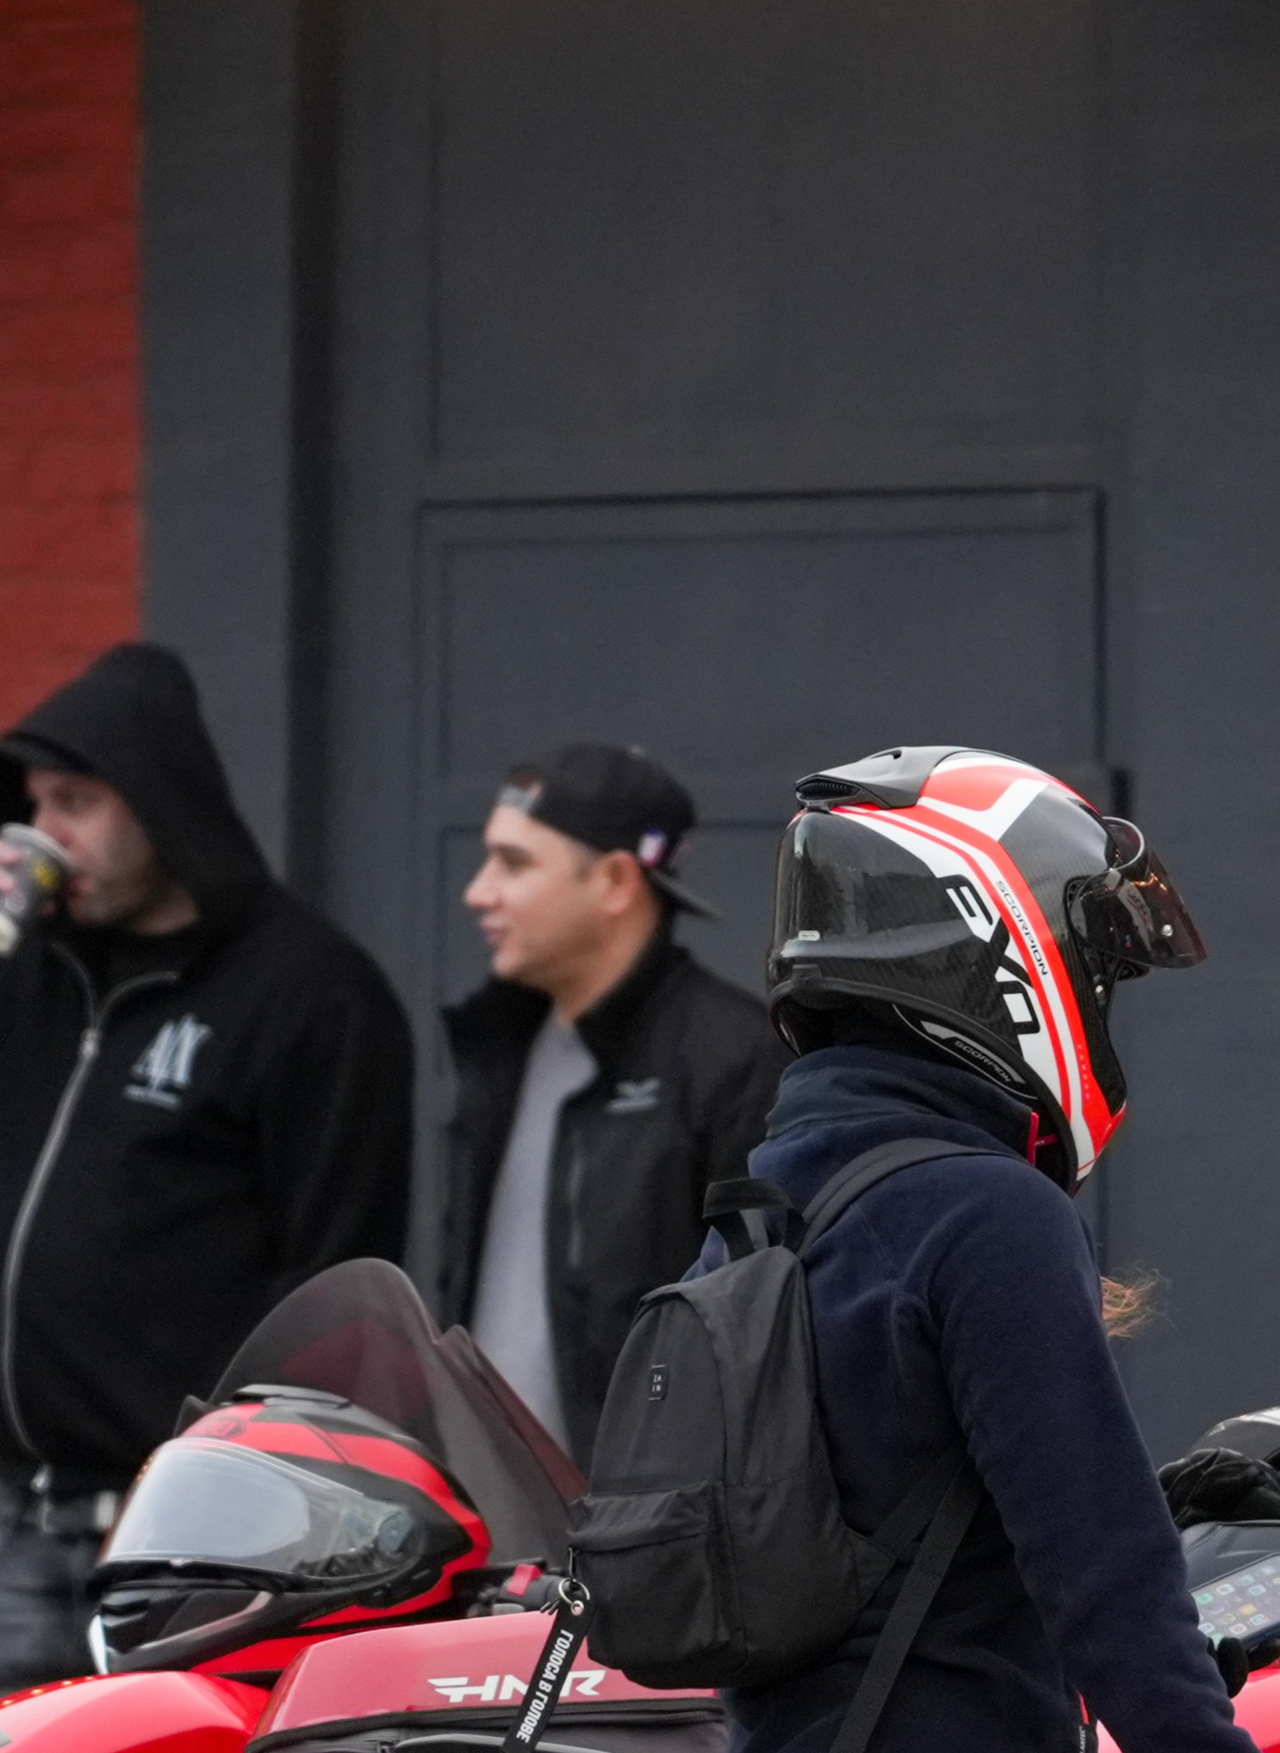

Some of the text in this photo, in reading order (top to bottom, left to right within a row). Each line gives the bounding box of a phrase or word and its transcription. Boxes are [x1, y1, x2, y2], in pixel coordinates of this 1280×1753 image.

[997, 880, 1048, 976] SCORPION
[954, 1040, 1012, 1082] SCORPION
[516, 1629, 574, 1744] ГОЛОСА В ГОЛОВЕ
